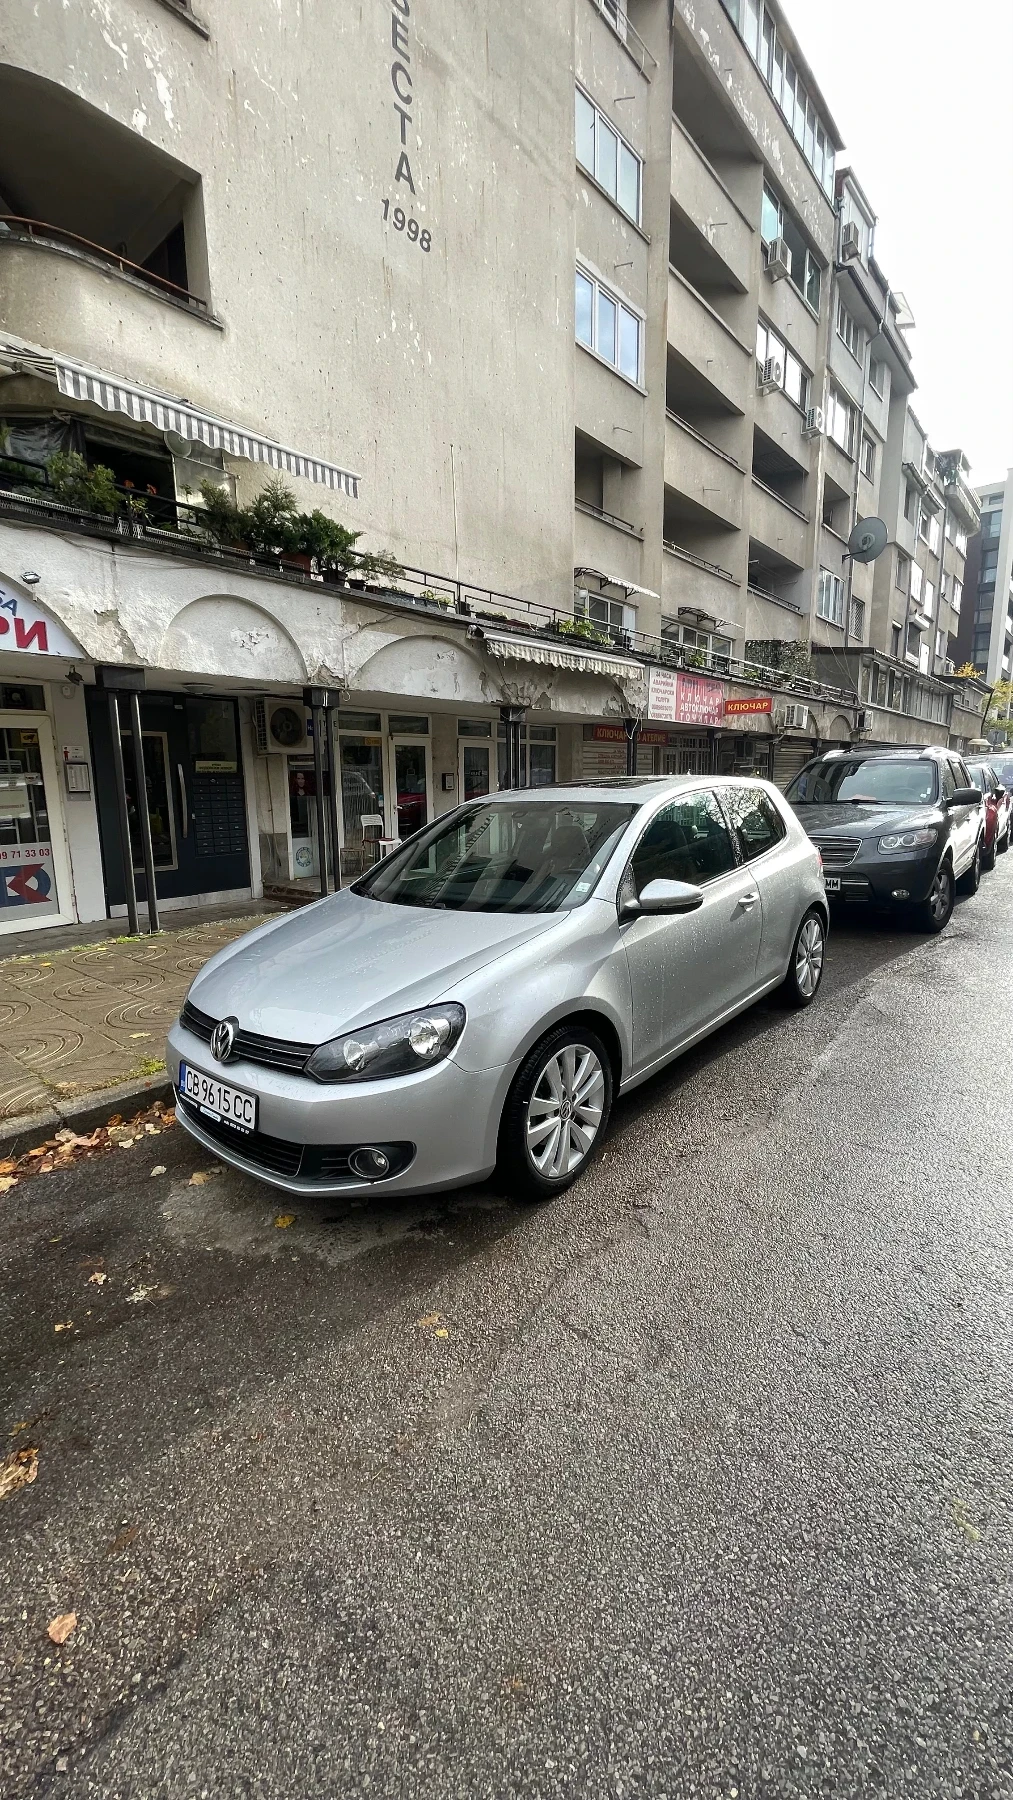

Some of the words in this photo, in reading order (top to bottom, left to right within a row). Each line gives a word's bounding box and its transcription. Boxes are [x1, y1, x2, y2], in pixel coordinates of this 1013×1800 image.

[381, 198, 432, 253] 1998
[681, 692, 719, 706] КЛЮЧАР
[728, 702, 769, 711] КЛЮЧАР
[642, 733, 666, 743] АТЕЛИЕ
[0, 851, 8, 860] 9
[10, 850, 21, 859] 71
[25, 849, 37, 858] 33
[39, 847, 50, 857] 03
[186, 1070, 199, 1096] CB
[201, 1078, 230, 1113] 9615
[233, 1094, 252, 1123] CC
